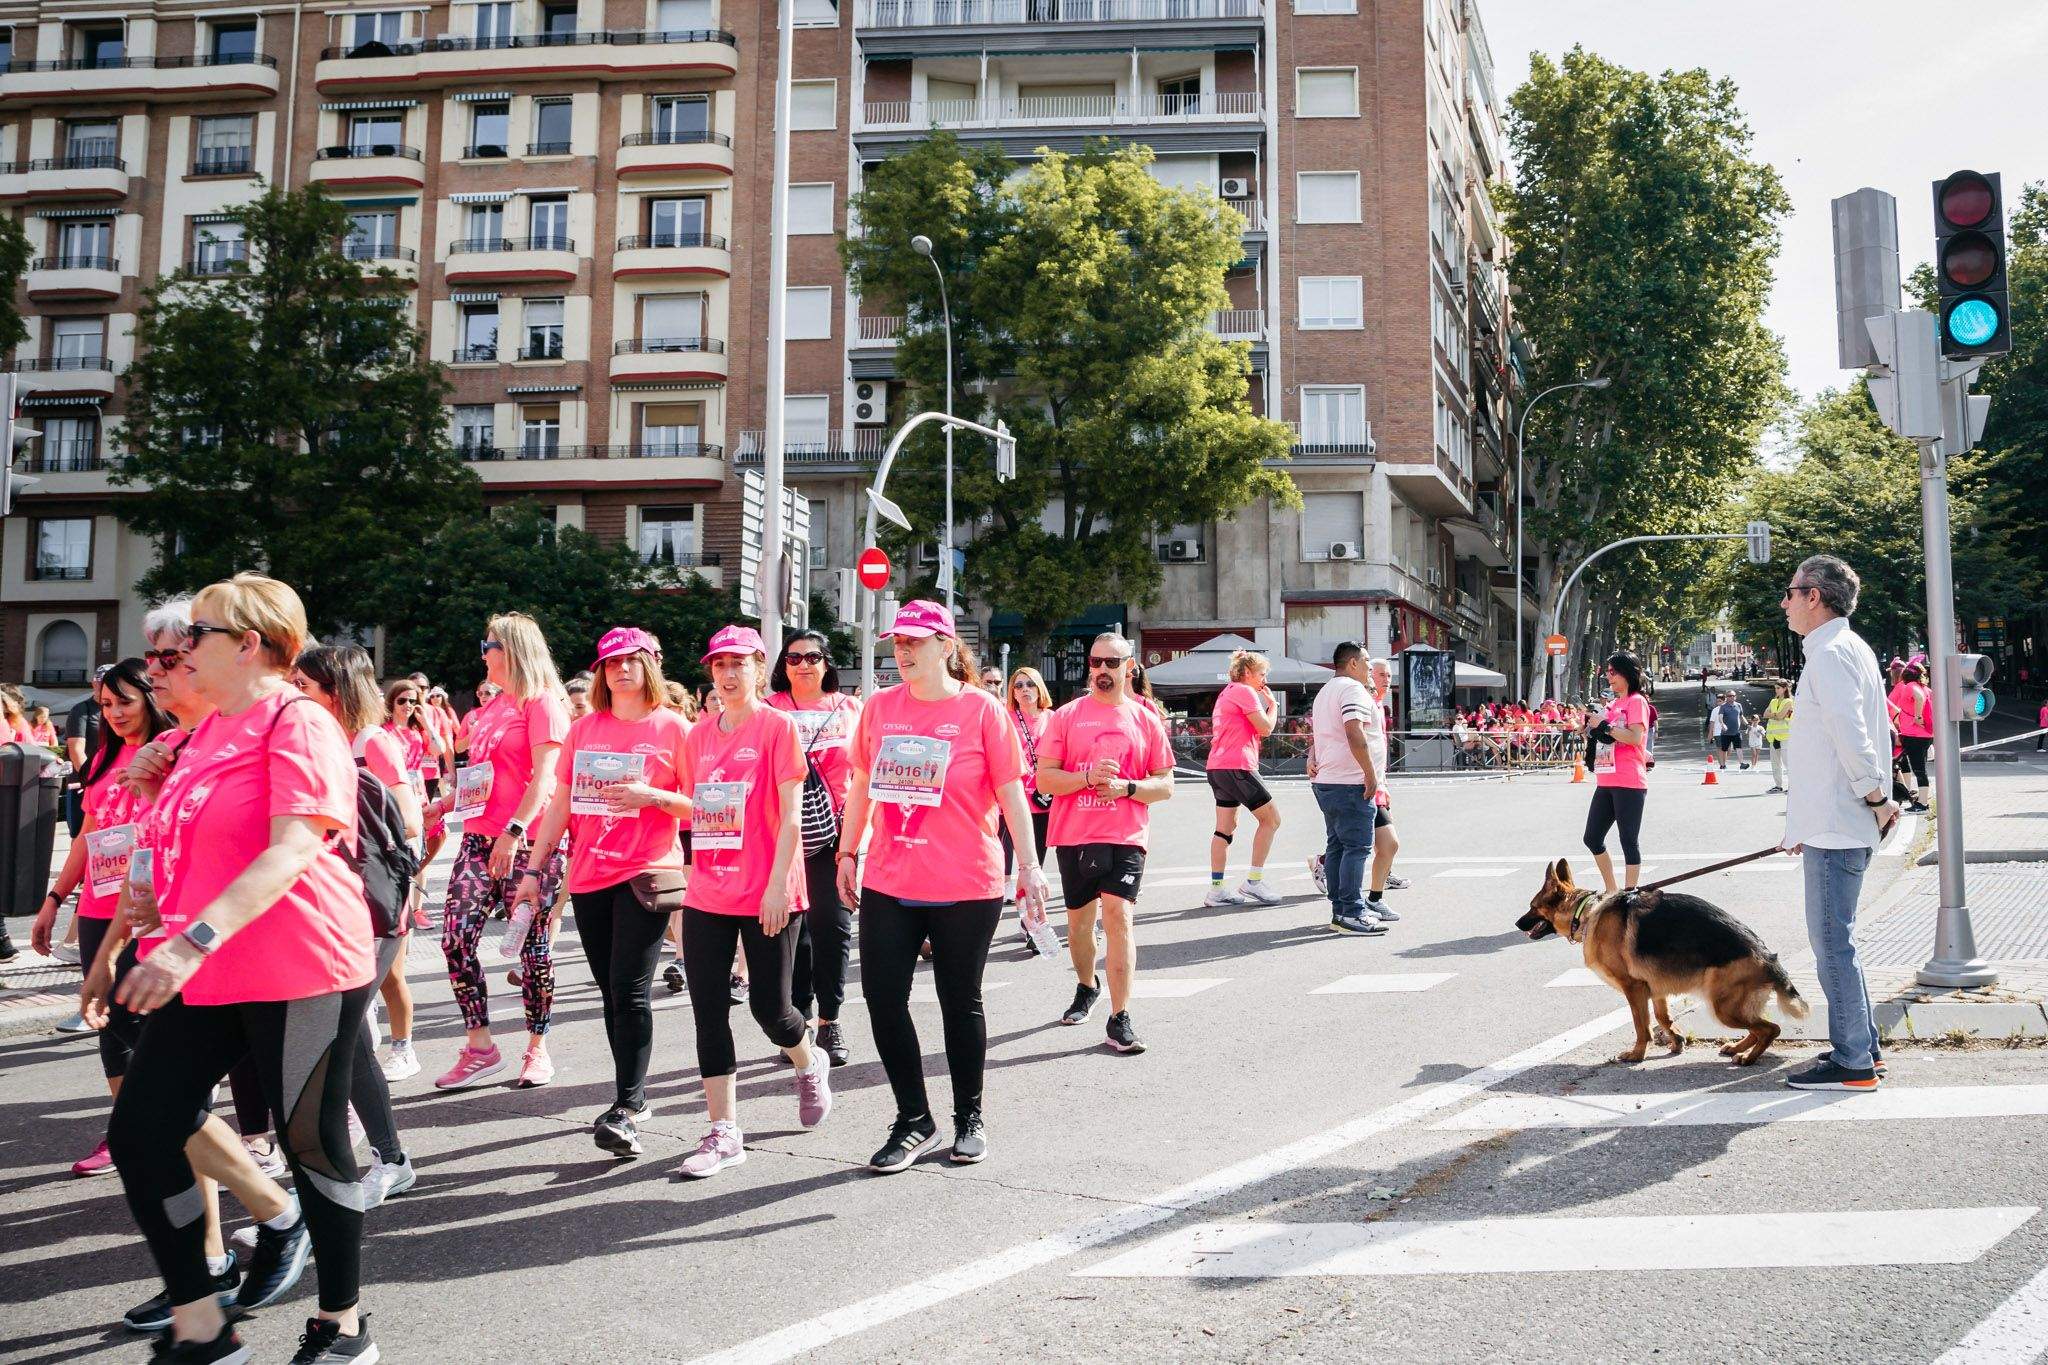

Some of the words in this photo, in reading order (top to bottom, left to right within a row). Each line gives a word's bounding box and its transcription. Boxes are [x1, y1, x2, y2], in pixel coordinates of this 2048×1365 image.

[895, 765, 922, 777] 016
[705, 813, 724, 822] 016
[105, 854, 127, 868] 016
